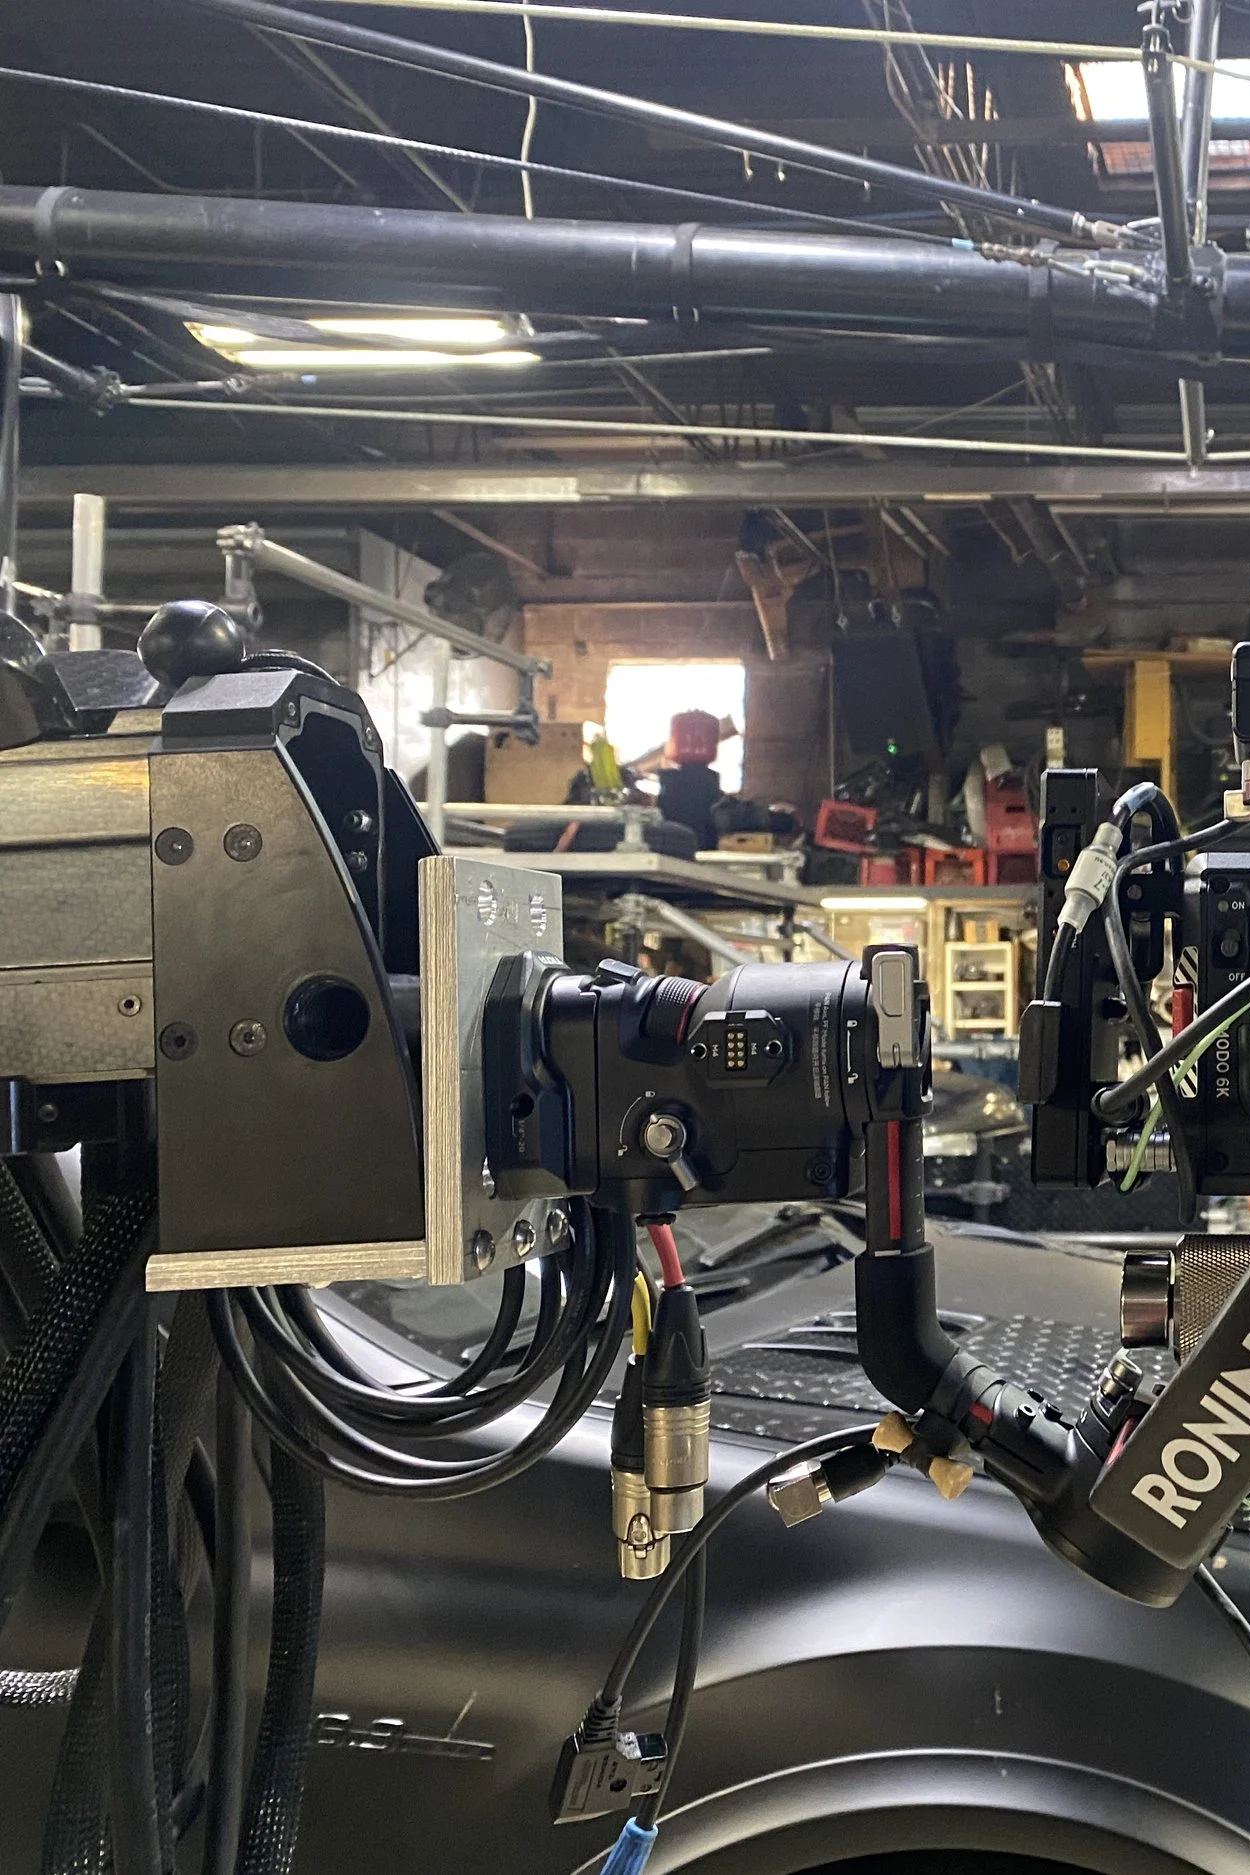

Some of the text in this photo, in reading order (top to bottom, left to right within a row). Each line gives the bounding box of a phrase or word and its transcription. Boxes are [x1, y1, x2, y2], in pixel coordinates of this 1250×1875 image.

[1231, 900, 1245, 910] ON
[1228, 972, 1246, 982] OFF
[1216, 1077, 1230, 1098] 6K
